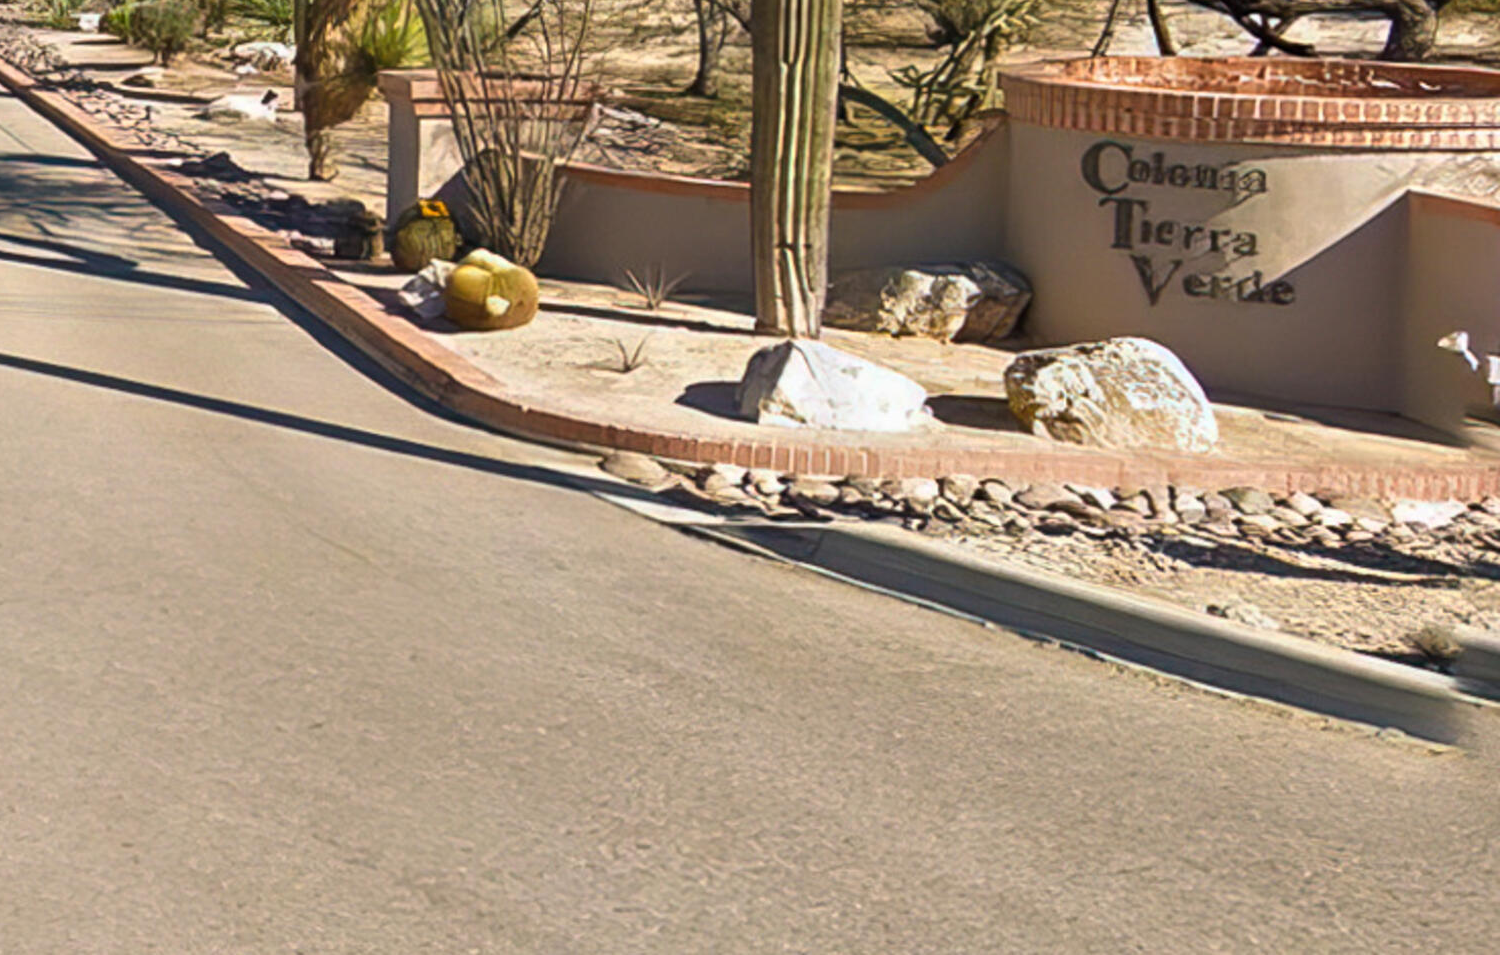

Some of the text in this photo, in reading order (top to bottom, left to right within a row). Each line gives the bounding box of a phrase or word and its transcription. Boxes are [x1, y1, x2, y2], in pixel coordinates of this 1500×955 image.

[1081, 140, 1267, 195] Colonia
[1098, 197, 1259, 256] Tierra
[1130, 253, 1295, 307] Verde
